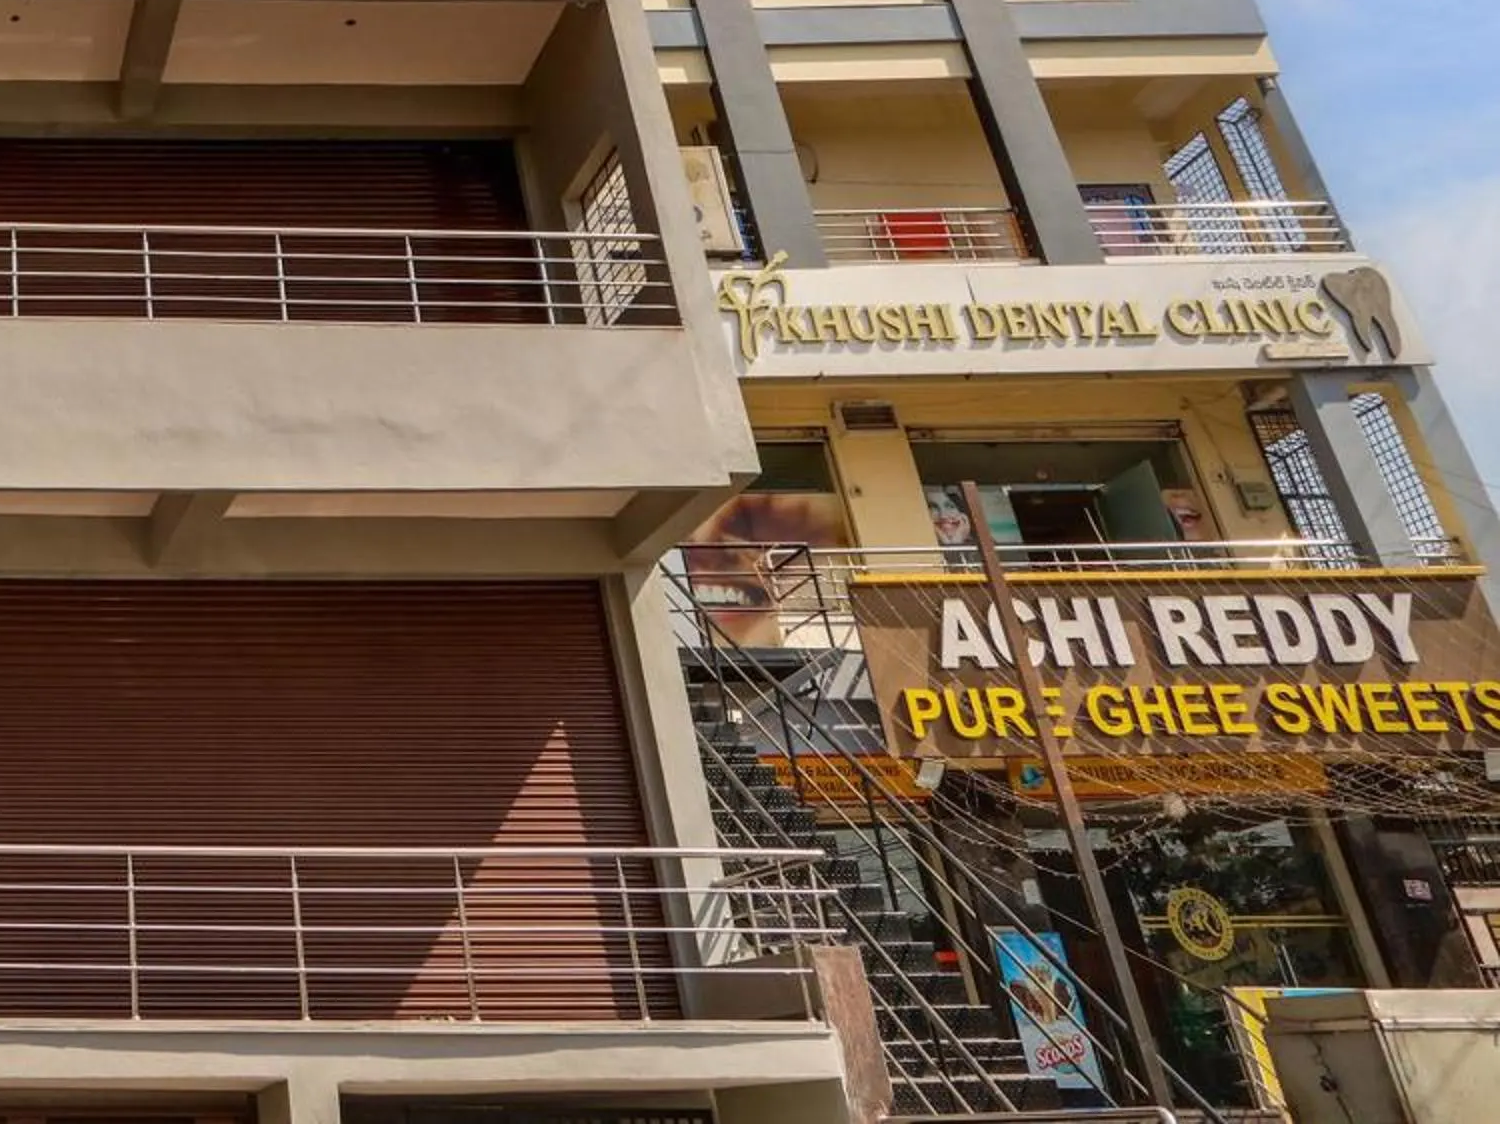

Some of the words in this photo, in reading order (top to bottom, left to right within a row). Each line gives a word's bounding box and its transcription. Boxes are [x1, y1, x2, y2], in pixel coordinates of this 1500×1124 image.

[774, 303, 959, 344] KHUSHI
[963, 299, 1158, 341] DENTAL
[1164, 298, 1332, 339] CLINIC
[940, 595, 1137, 669] ACHI
[1149, 591, 1420, 666] REDDY
[1086, 683, 1261, 738] GHEE
[1265, 680, 1500, 734] SWEETS
